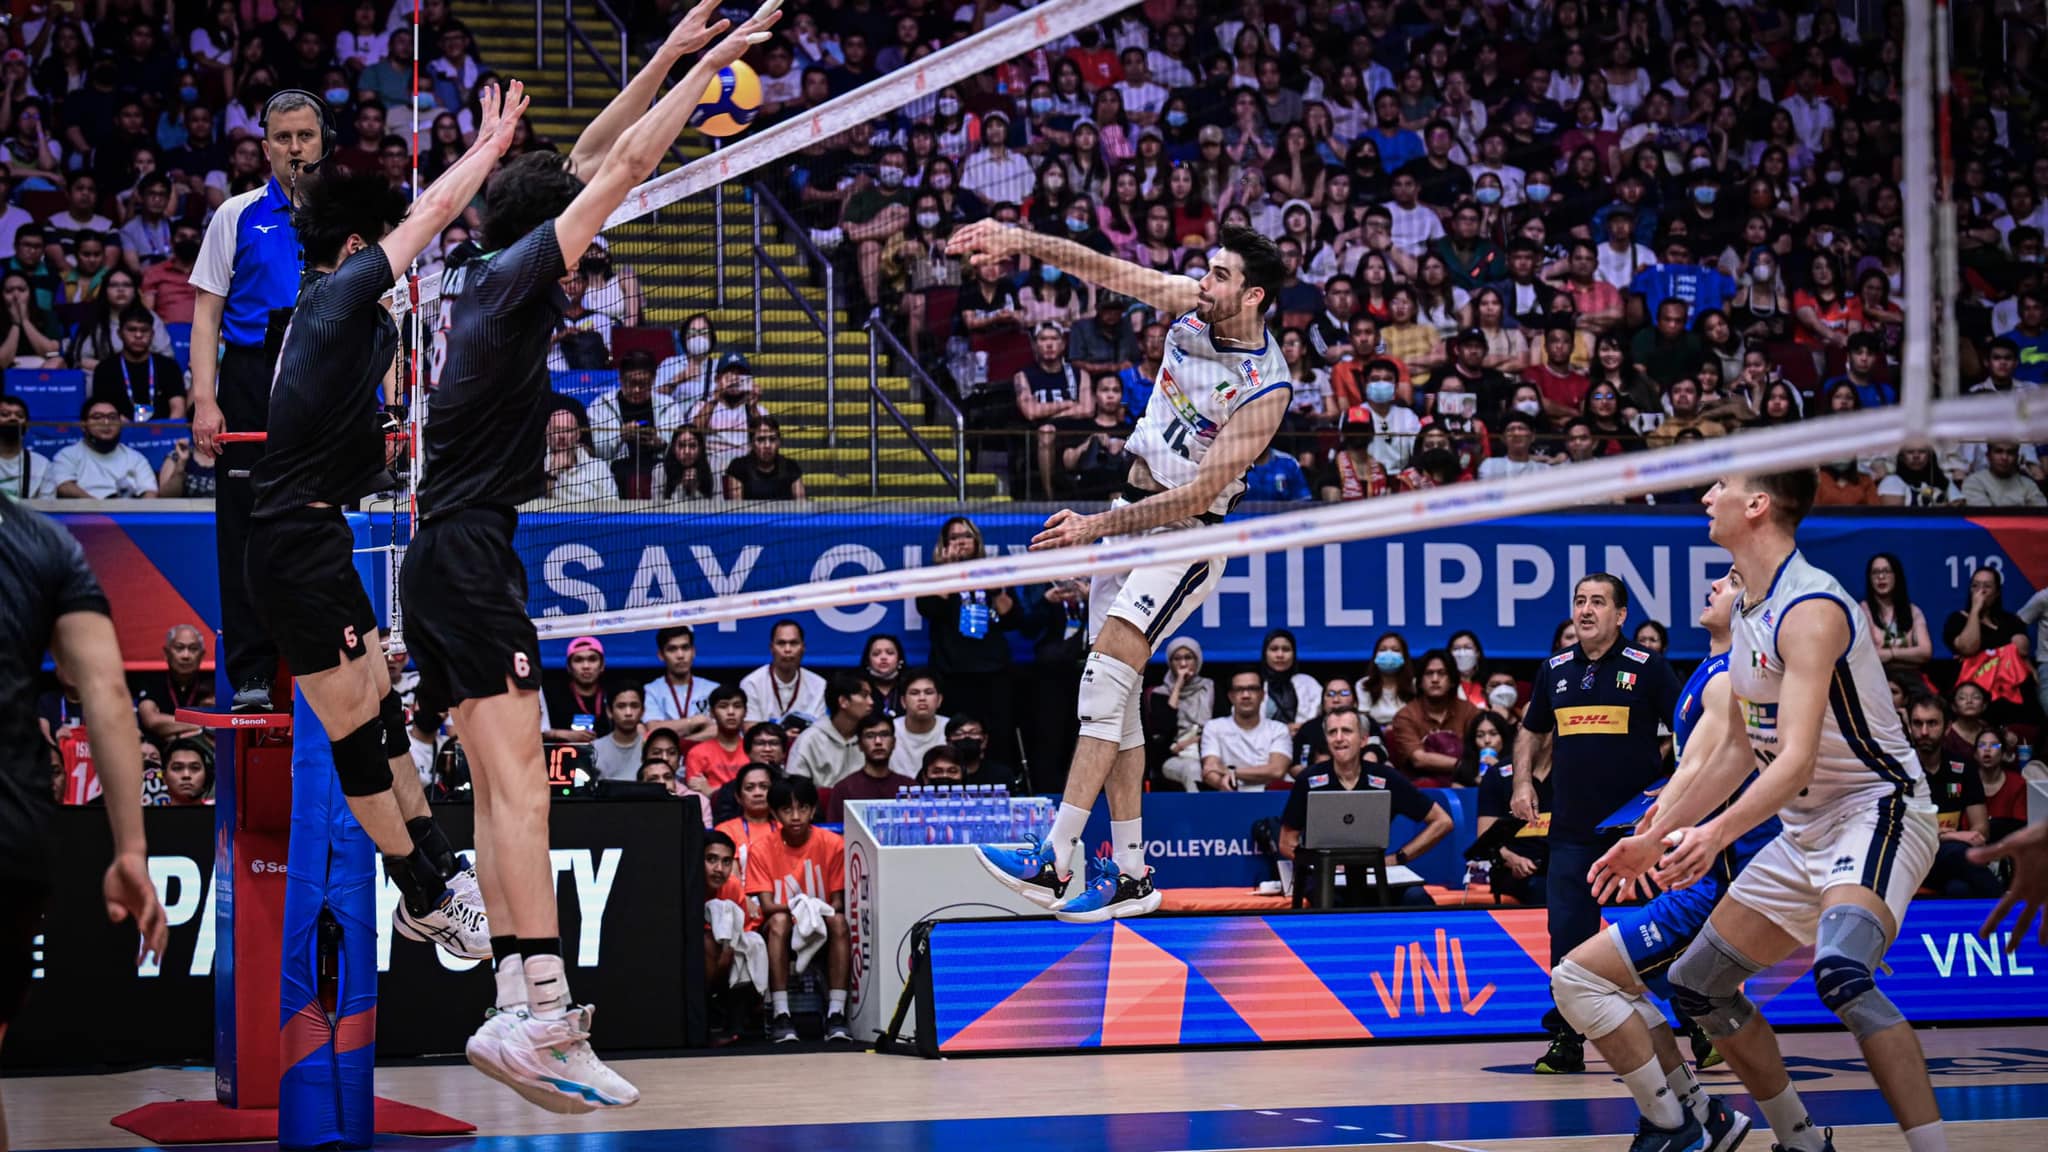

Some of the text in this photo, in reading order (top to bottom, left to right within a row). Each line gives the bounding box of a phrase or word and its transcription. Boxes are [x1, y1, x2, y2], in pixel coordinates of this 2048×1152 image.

[344, 625, 358, 648] 5
[514, 652, 530, 677] 6
[267, 862, 287, 873] Se
[1921, 931, 2035, 978] VNL
[1370, 928, 1497, 1018] VNL
